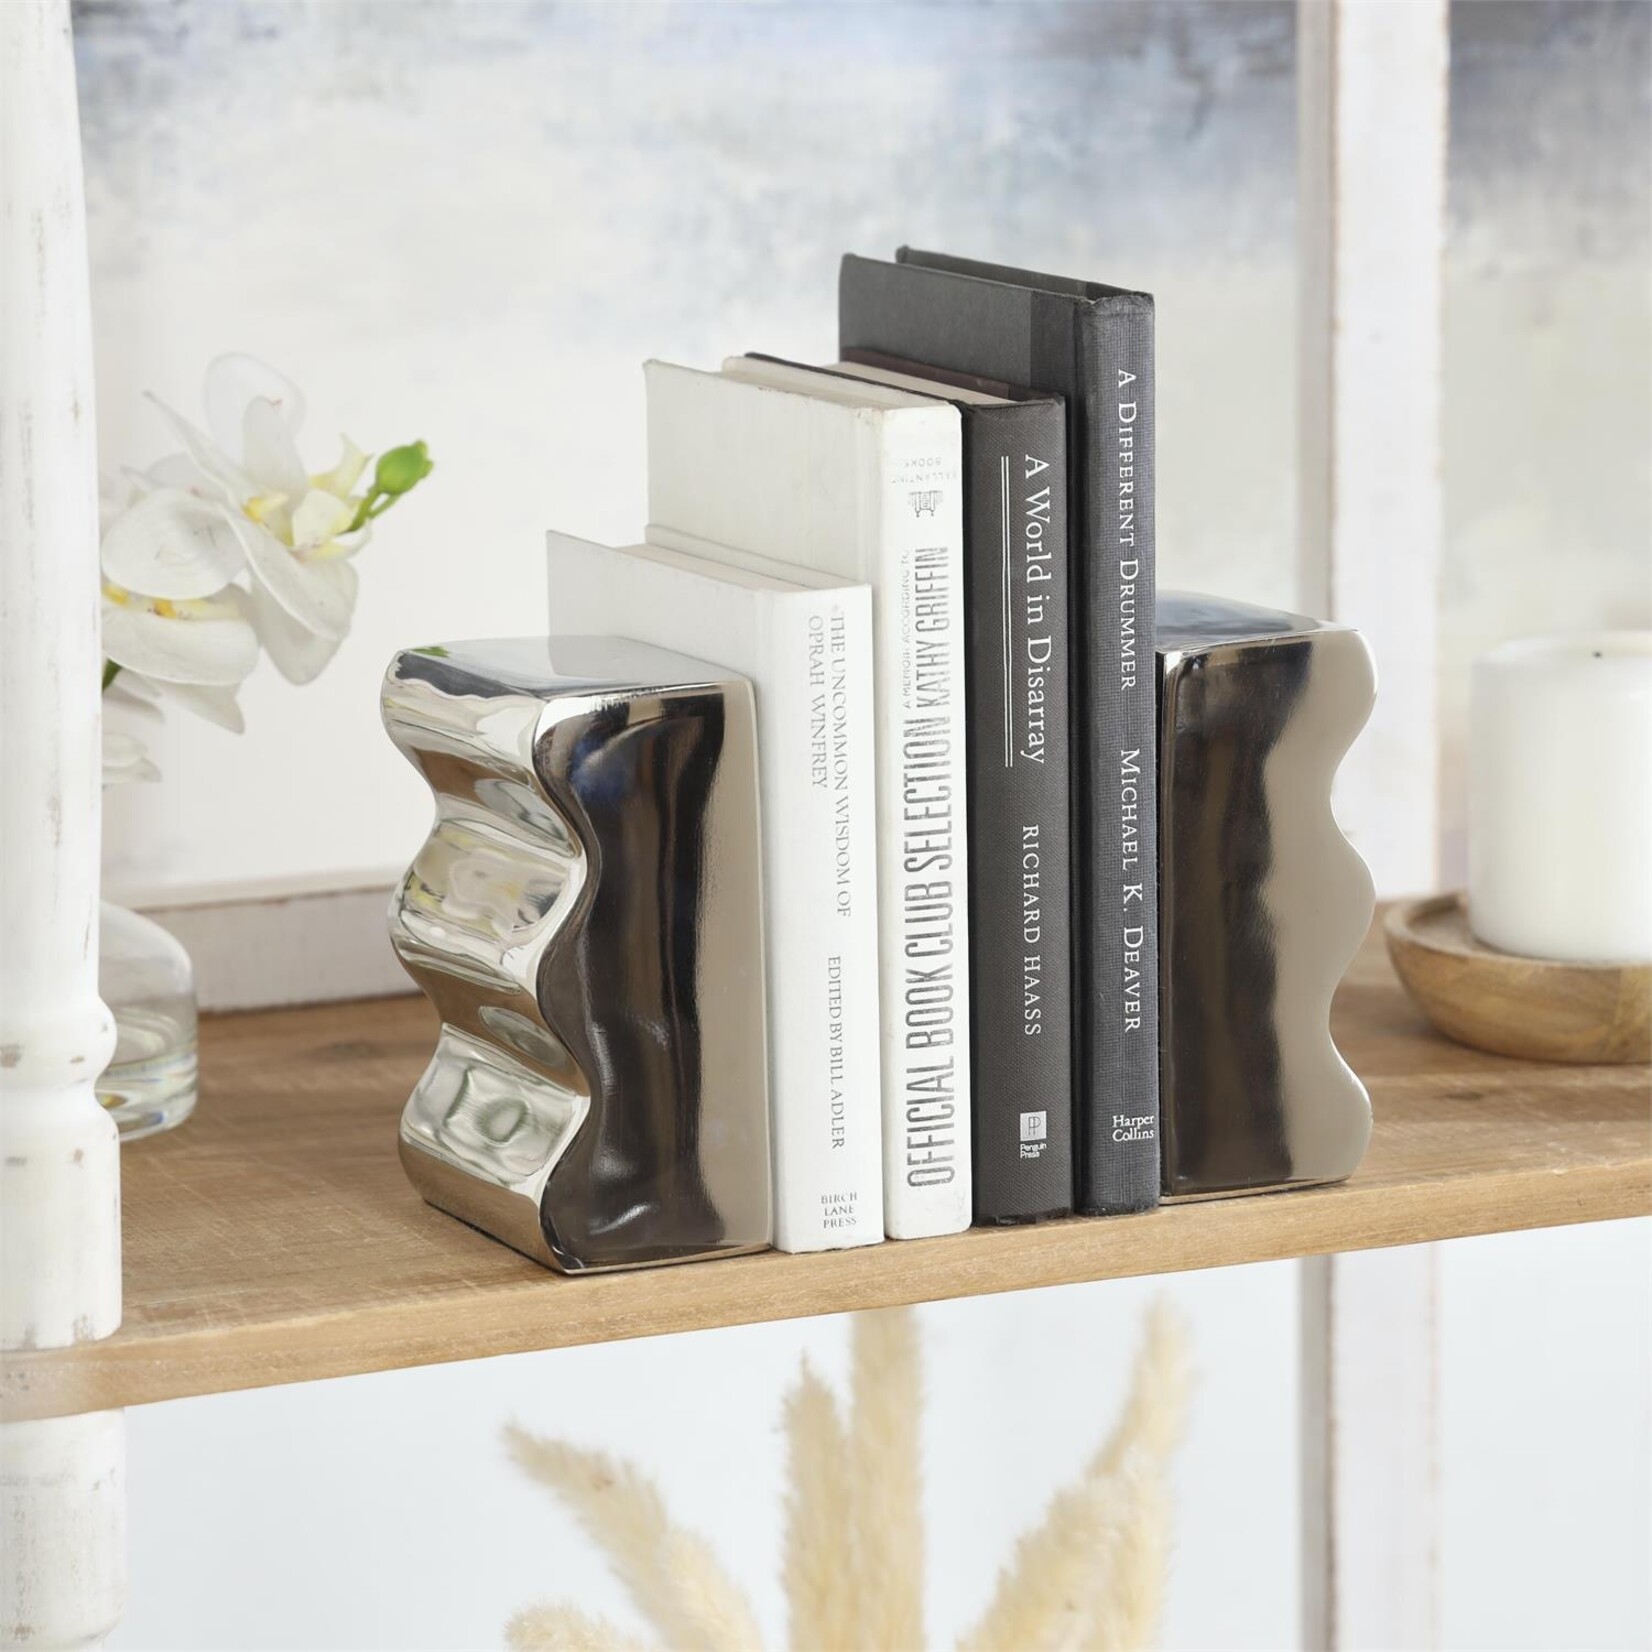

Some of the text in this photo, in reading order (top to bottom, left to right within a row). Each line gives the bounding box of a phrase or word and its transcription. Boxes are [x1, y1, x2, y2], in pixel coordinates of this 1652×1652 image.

[1020, 454, 1052, 764] A World in Disarray
[1118, 369, 1139, 691] A DIFFERENT DRUMMER
[808, 615, 828, 789] OPRAH WINFREY
[914, 546, 950, 708] KATHY GRIFFIN
[830, 613, 852, 917] THE UNCOMMON WISDOM OF
[903, 715, 955, 1187] OFFICIAL BOOK CLUB SELECTION
[1022, 824, 1042, 1036] RICHARD HAASS
[1121, 748, 1144, 1033] MICHAEL K. DEAVER
[828, 956, 845, 1149] EDITED BY BILL ADLER
[1112, 1114, 1155, 1129] Harper
[1112, 1127, 1155, 1142] Collins
[821, 1192, 858, 1205] BIRCH
[823, 1217, 857, 1229] PRESS
[824, 1204, 854, 1217] LANE
[1020, 1142, 1047, 1152] Penguin
